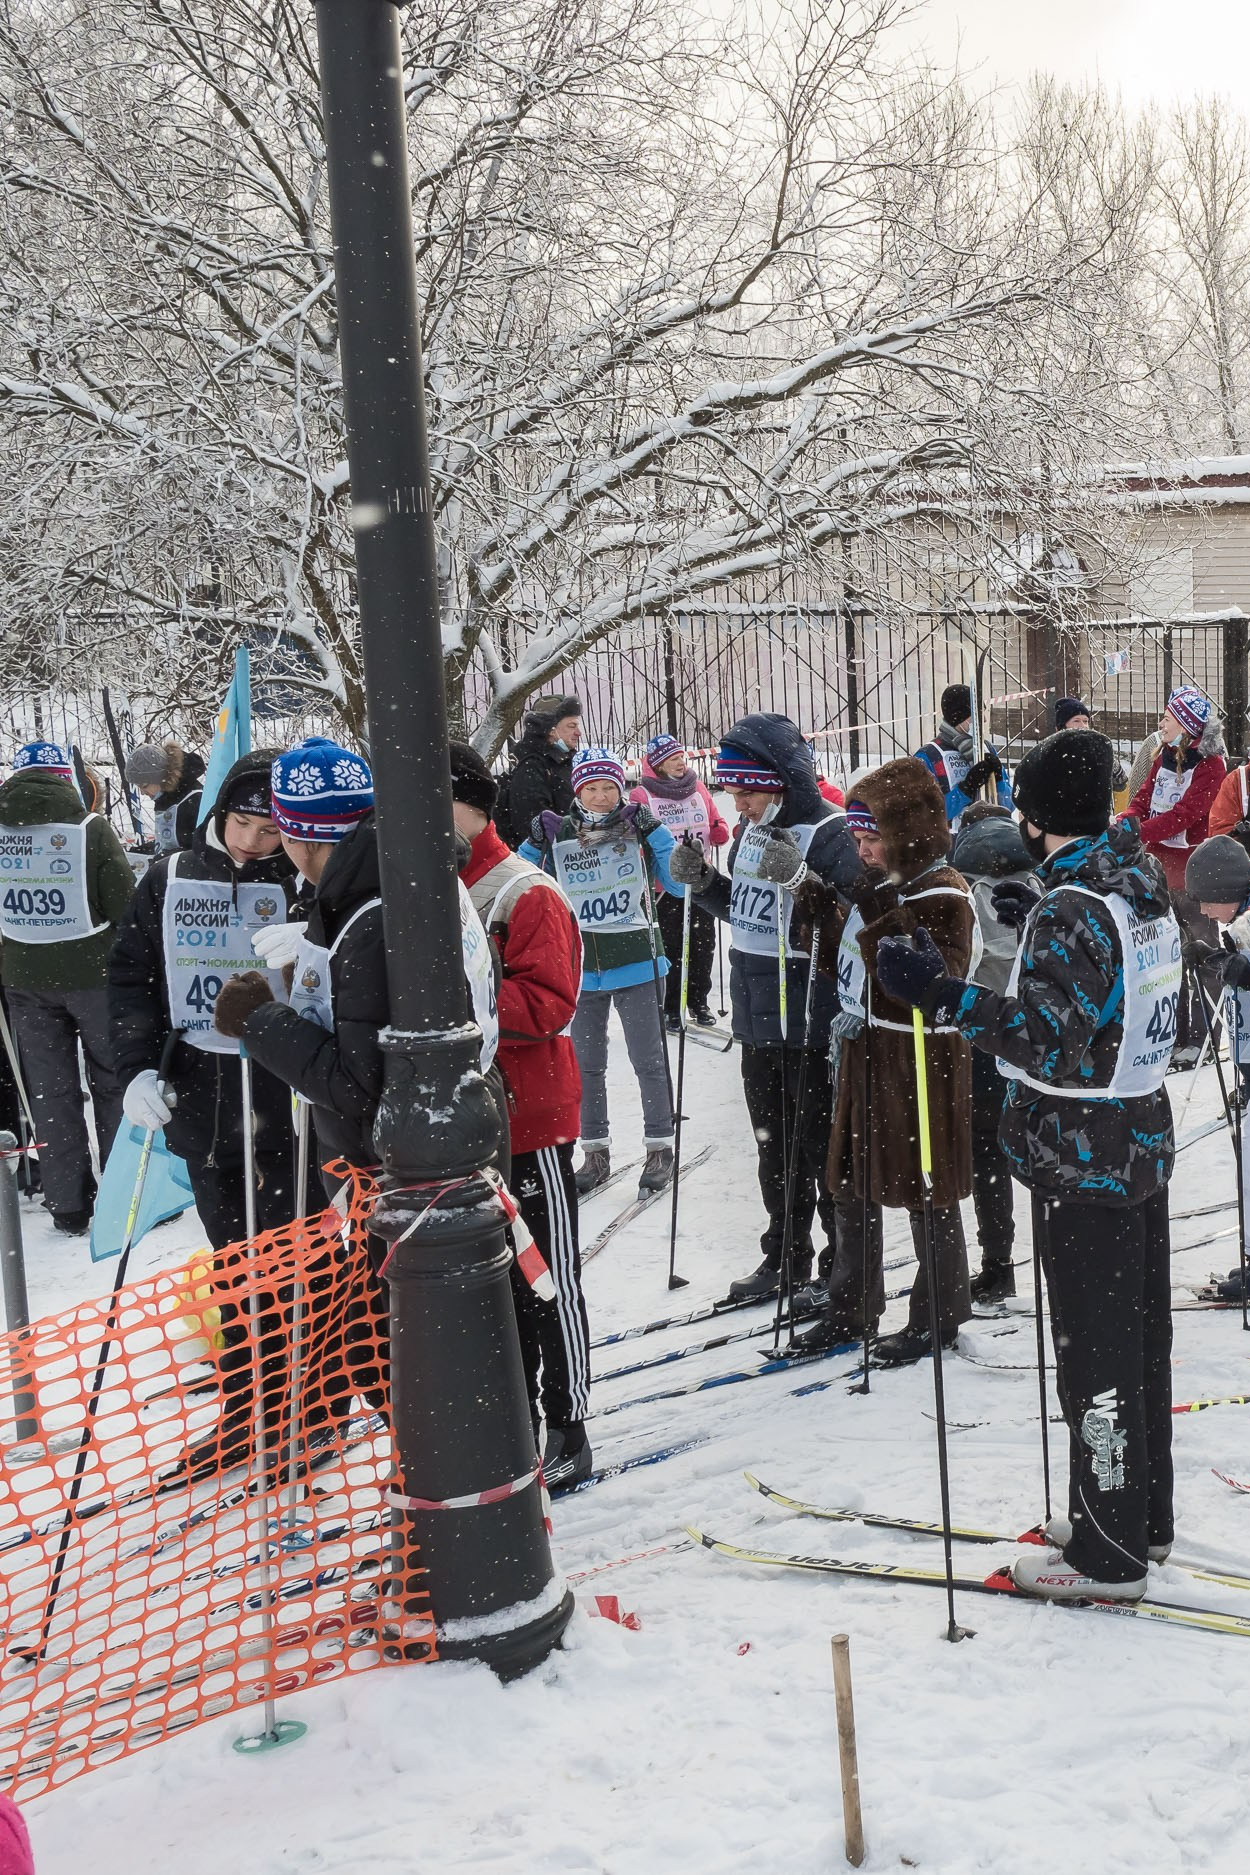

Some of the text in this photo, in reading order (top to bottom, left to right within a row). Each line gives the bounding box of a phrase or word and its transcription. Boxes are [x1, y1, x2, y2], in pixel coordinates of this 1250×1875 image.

[0, 835, 33, 845] ЫЖНЯ
[0, 846, 32, 855] ОССИИ
[563, 849, 599, 864] ЛЫЖНЯ
[0, 857, 30, 869] 021
[565, 858, 600, 872] РОССИИ
[568, 869, 602, 884] 2021
[3, 888, 66, 915] 4039
[174, 898, 230, 912] ЛЫЖНЯ
[579, 889, 631, 923] 4043
[731, 882, 776, 922] 4172
[175, 913, 229, 927] РОССИИ
[176, 930, 227, 947] 2021
[186, 974, 223, 1014] 49
[1035, 1576, 1077, 1587] NEXT
